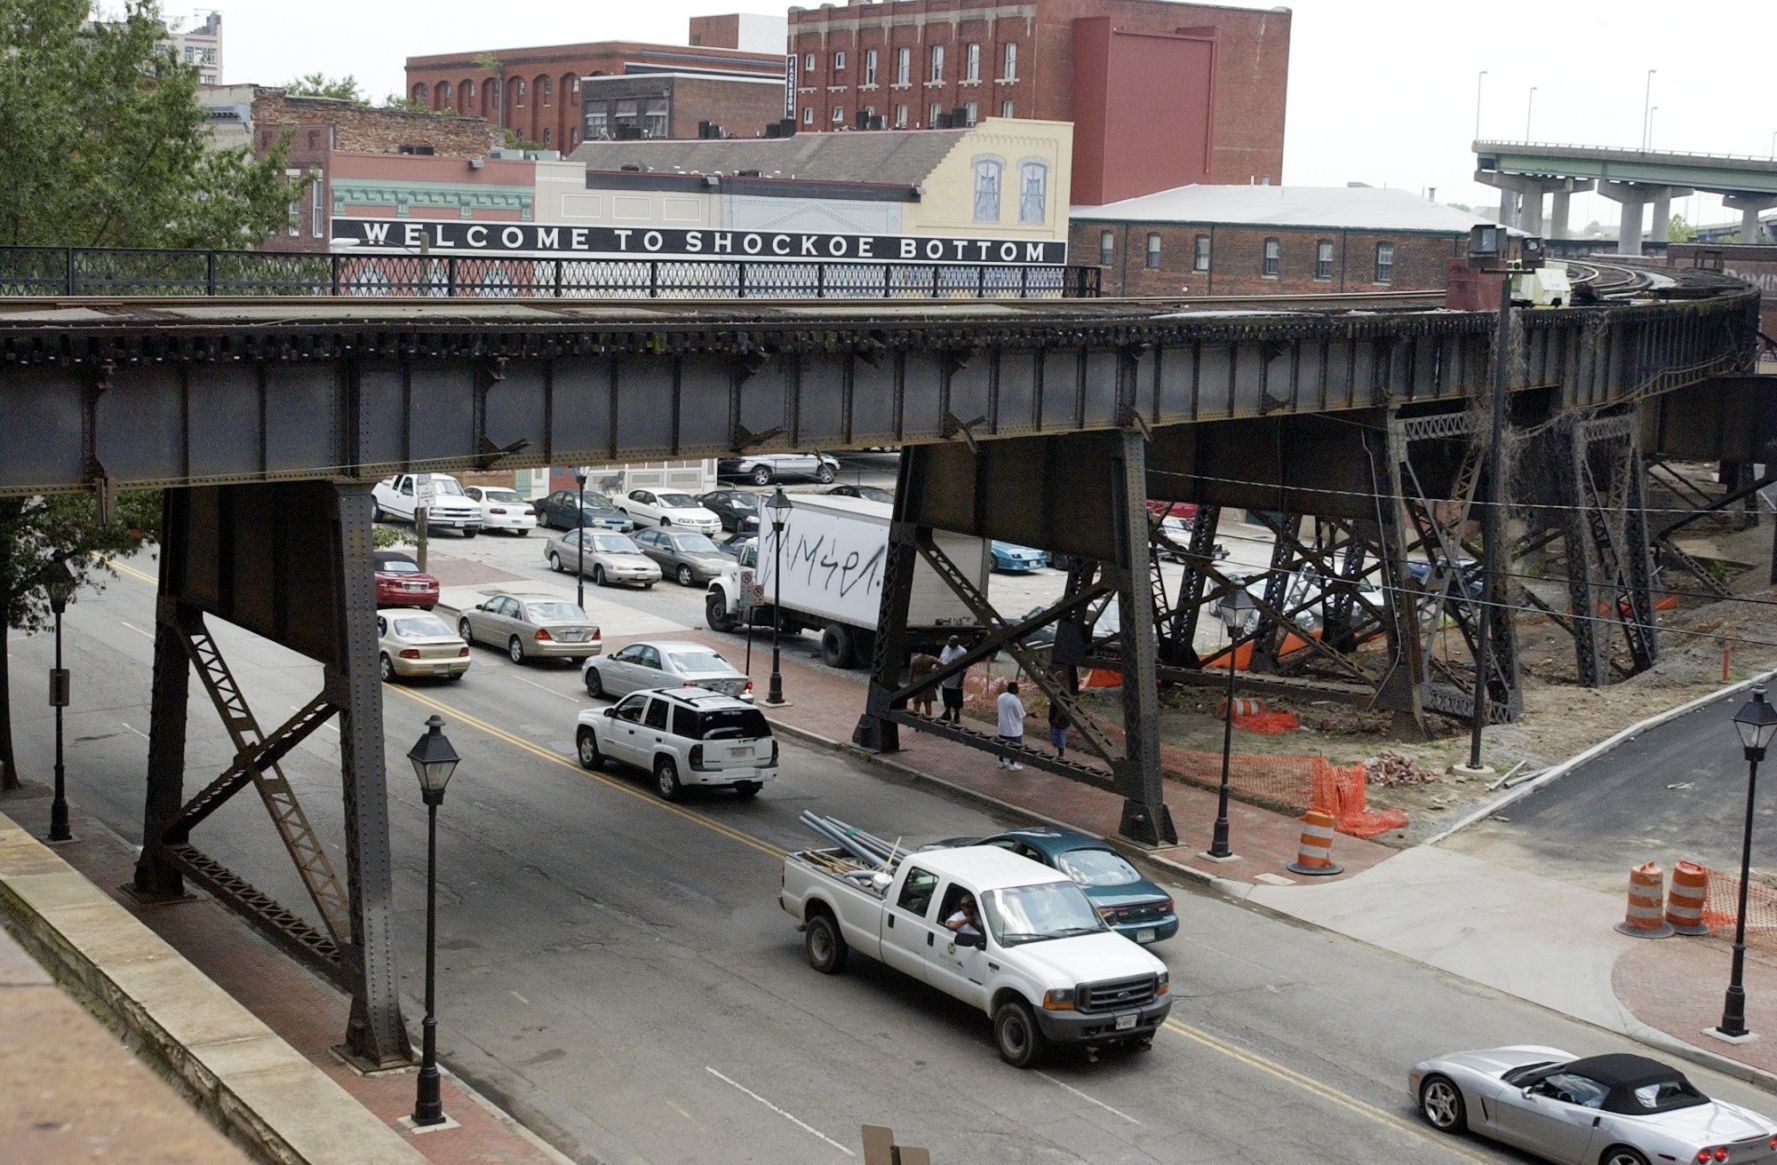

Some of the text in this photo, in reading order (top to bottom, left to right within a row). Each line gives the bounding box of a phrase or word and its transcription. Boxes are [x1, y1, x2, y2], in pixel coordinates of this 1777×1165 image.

[363, 222, 1044, 262] WELCOME TO SHOCKOE BOTTOM
